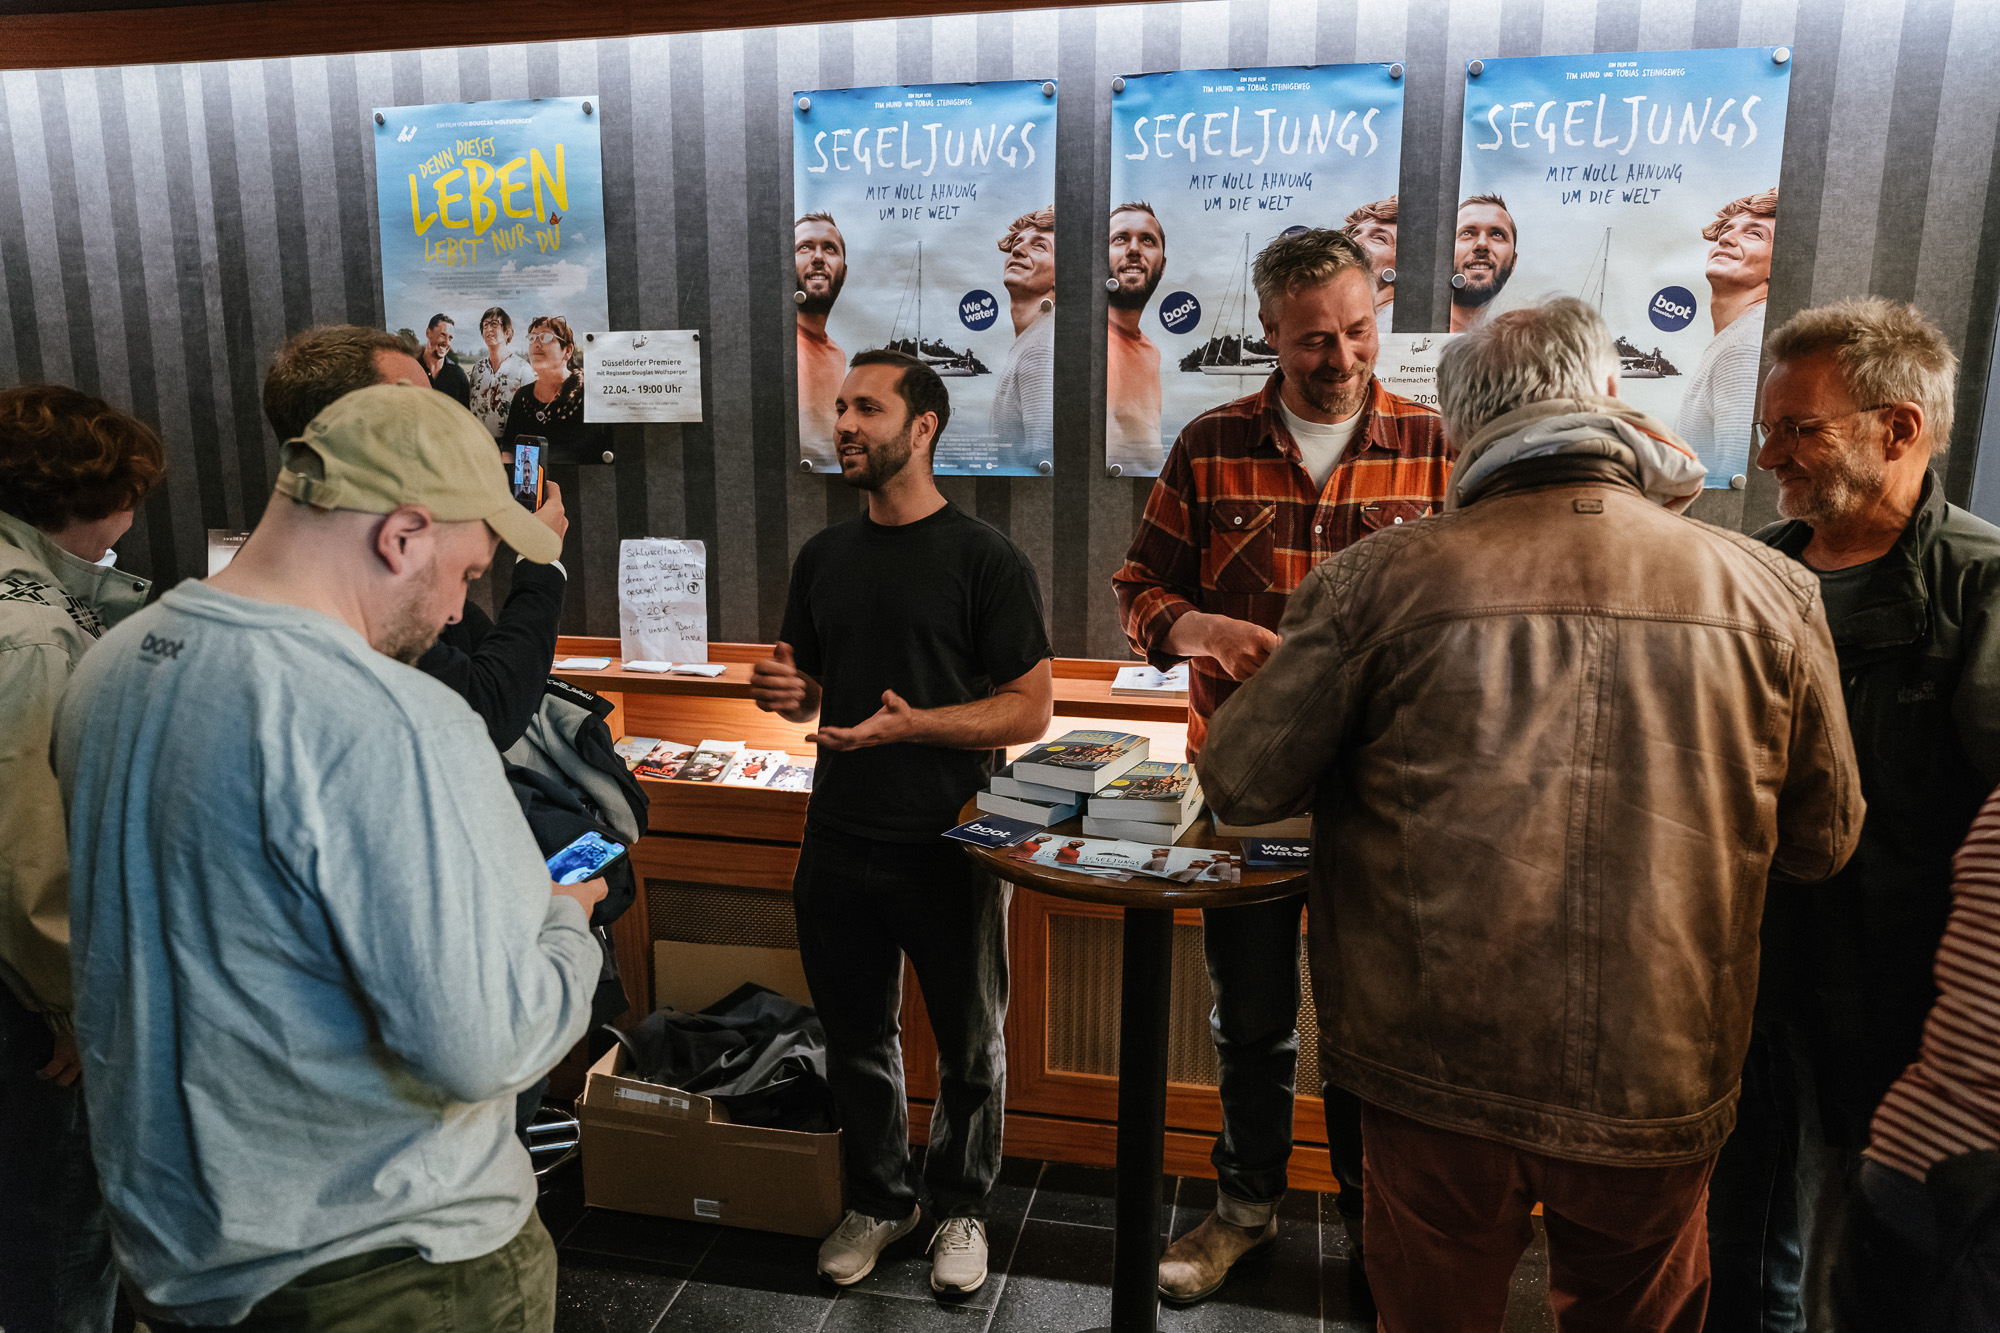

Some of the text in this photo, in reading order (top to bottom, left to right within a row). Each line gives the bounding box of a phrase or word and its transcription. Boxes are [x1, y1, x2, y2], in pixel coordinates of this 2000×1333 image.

[1566, 72, 1578, 80] TIM
[1580, 71, 1600, 79] HUND
[1616, 69, 1639, 77] TOBIAS
[1642, 68, 1685, 77] STEINIGEWEG
[1215, 85, 1233, 93] HUND
[1247, 83, 1268, 92] TOBIAS
[1271, 82, 1310, 91] STEINIGEWEG
[915, 99, 934, 107] TOBIAS
[936, 98, 972, 107] STEINIGEWEG
[1476, 93, 1762, 156] SEGELJUNGS
[1125, 105, 1380, 165] SEGELJUNGS
[807, 120, 1036, 176] SEGELJUNGS
[418, 136, 496, 179] DENN DIESES
[1189, 172, 1312, 191] MIT NULL AHNUNG
[1546, 163, 1682, 183] MIT NULL AHNUNG
[408, 143, 569, 236] LEBEN
[866, 183, 977, 201] MIT NULL AHNUNG
[1562, 187, 1661, 205] UM DIE WELT
[1204, 195, 1293, 211] UM DIE WELT
[880, 205, 960, 220] UM DIE WELT
[425, 223, 560, 267] LEBST NUR DU
[962, 301, 981, 314] We
[965, 308, 994, 323] water
[1162, 299, 1196, 323] boot
[1655, 294, 1692, 320] boot
[602, 358, 681, 367] Düsseldorfer Premiere
[603, 385, 630, 394] 22.04.
[638, 384, 663, 394] 19:00
[665, 384, 682, 394] Uhr
[1413, 394, 1438, 404] 20:0
[968, 823, 1011, 838] boot
[1261, 844, 1289, 852] We
